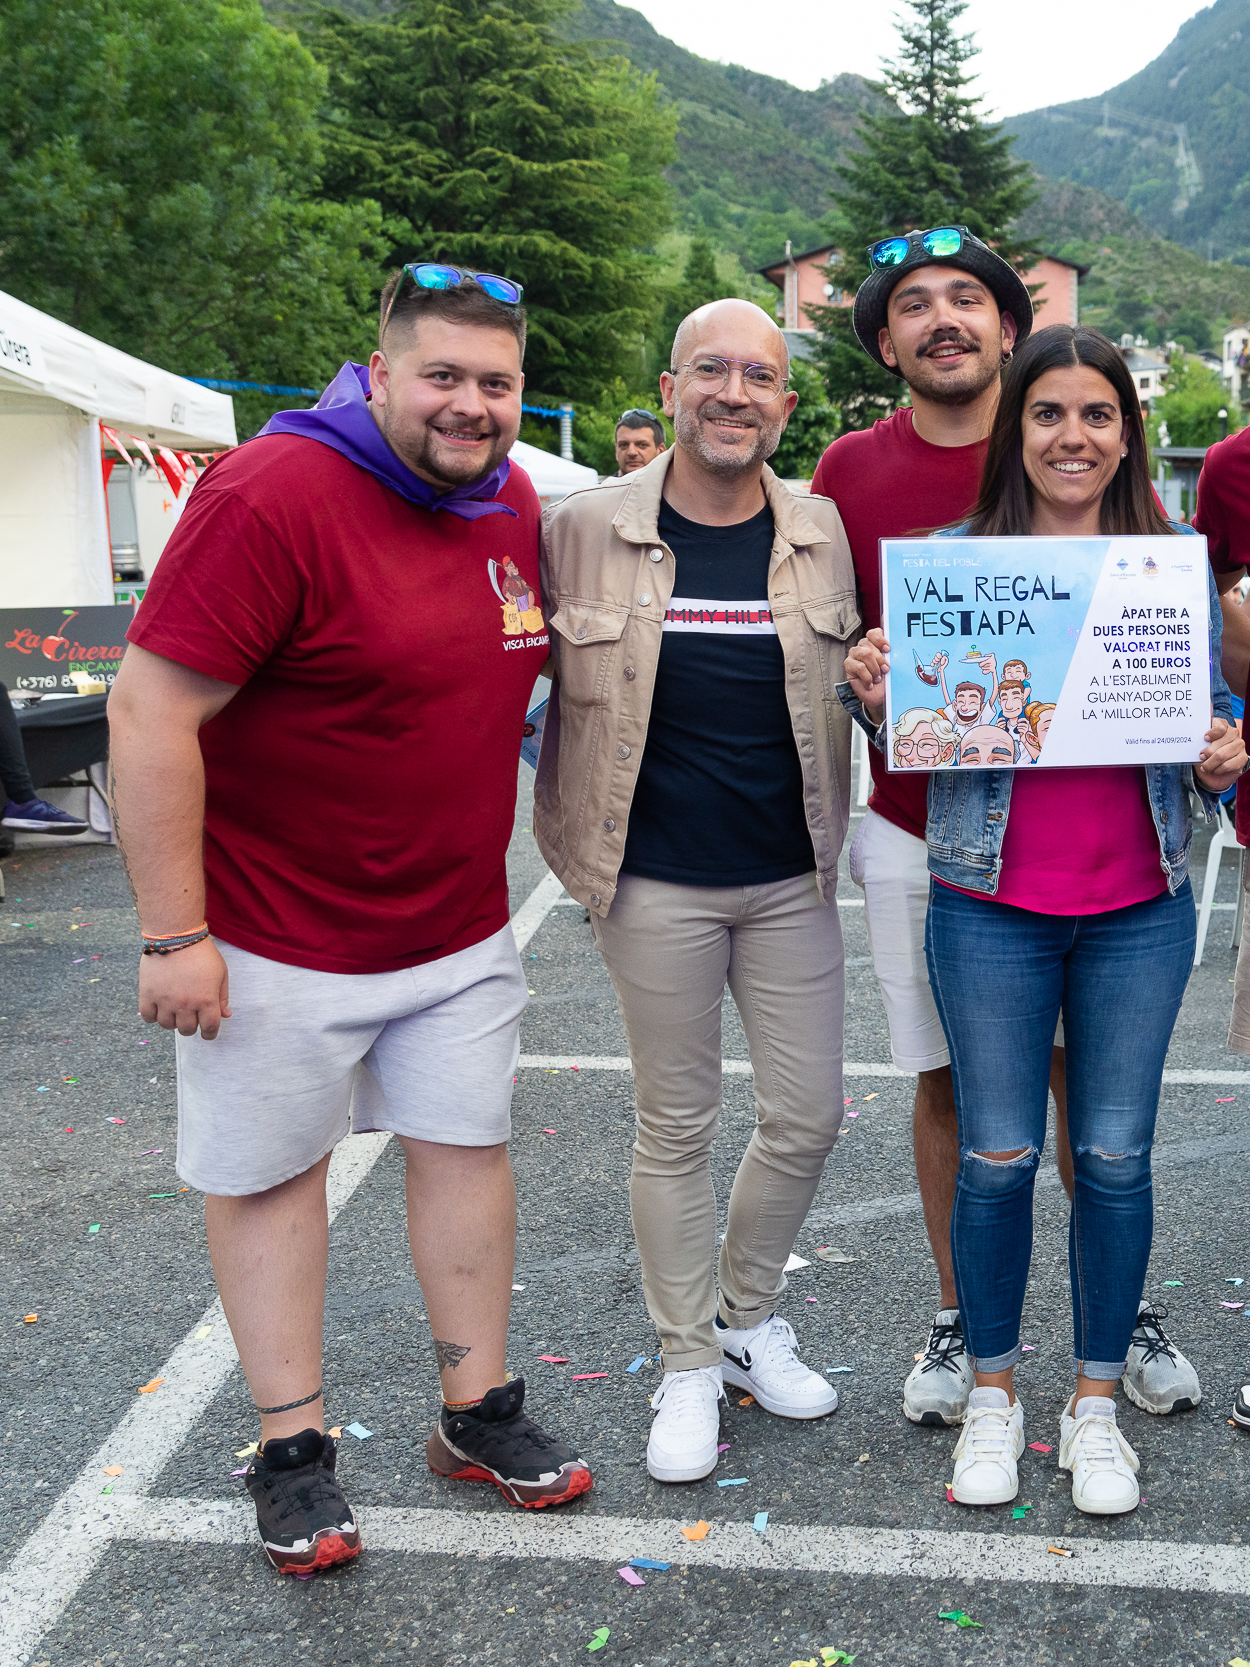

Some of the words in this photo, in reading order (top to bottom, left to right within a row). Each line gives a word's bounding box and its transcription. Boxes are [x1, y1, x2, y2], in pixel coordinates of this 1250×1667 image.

[903, 559, 931, 568] FESTA
[933, 558, 951, 567] DEL
[953, 557, 983, 567] POBLE
[904, 577, 964, 603] VAL
[975, 575, 1071, 602] REGAL
[664, 608, 718, 623] MMY
[1121, 605, 1152, 619] ÀPAT
[1156, 608, 1177, 619] PER
[1180, 607, 1190, 618] A
[906, 609, 1036, 637] FESTAPA
[1093, 625, 1124, 637] DUES
[1128, 624, 1190, 636] PERSONES
[5, 628, 42, 654] La
[503, 639, 526, 651] VISCA
[1103, 641, 1161, 653] VALORAT
[1164, 640, 1191, 652] FINS
[1112, 658, 1122, 669] A
[1126, 658, 1147, 669] 100
[1151, 656, 1191, 668] EUROS
[17, 675, 57, 689] (+376)
[1090, 676, 1100, 687] A
[1103, 673, 1192, 686] L'ESTABLIMENT
[1087, 690, 1172, 703] GUANYADOR
[1175, 689, 1192, 701] DE
[1082, 709, 1098, 720] LA
[1101, 707, 1151, 719] 'MILLOR
